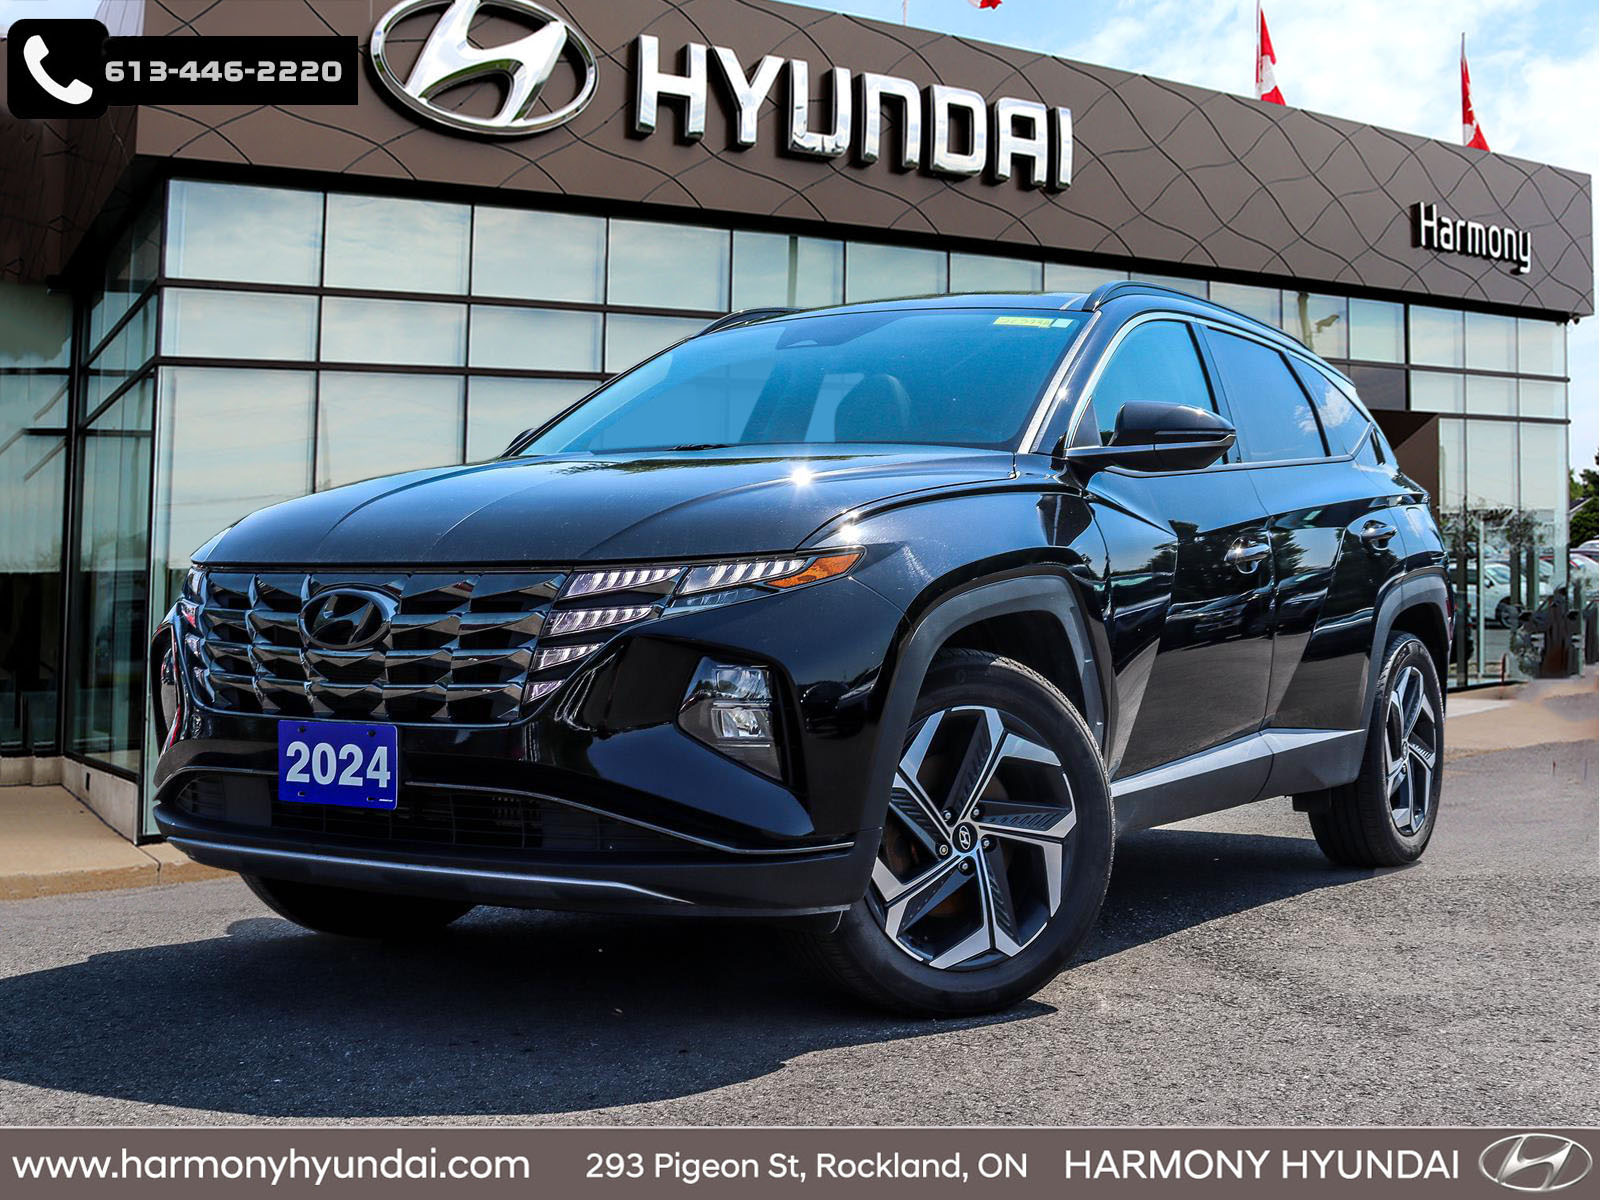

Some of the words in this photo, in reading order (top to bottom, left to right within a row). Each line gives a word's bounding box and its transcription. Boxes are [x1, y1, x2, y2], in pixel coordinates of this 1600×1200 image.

[635, 34, 1074, 191] HYUNDAI
[1419, 201, 1532, 274] Harmony
[286, 741, 391, 788] 2024
